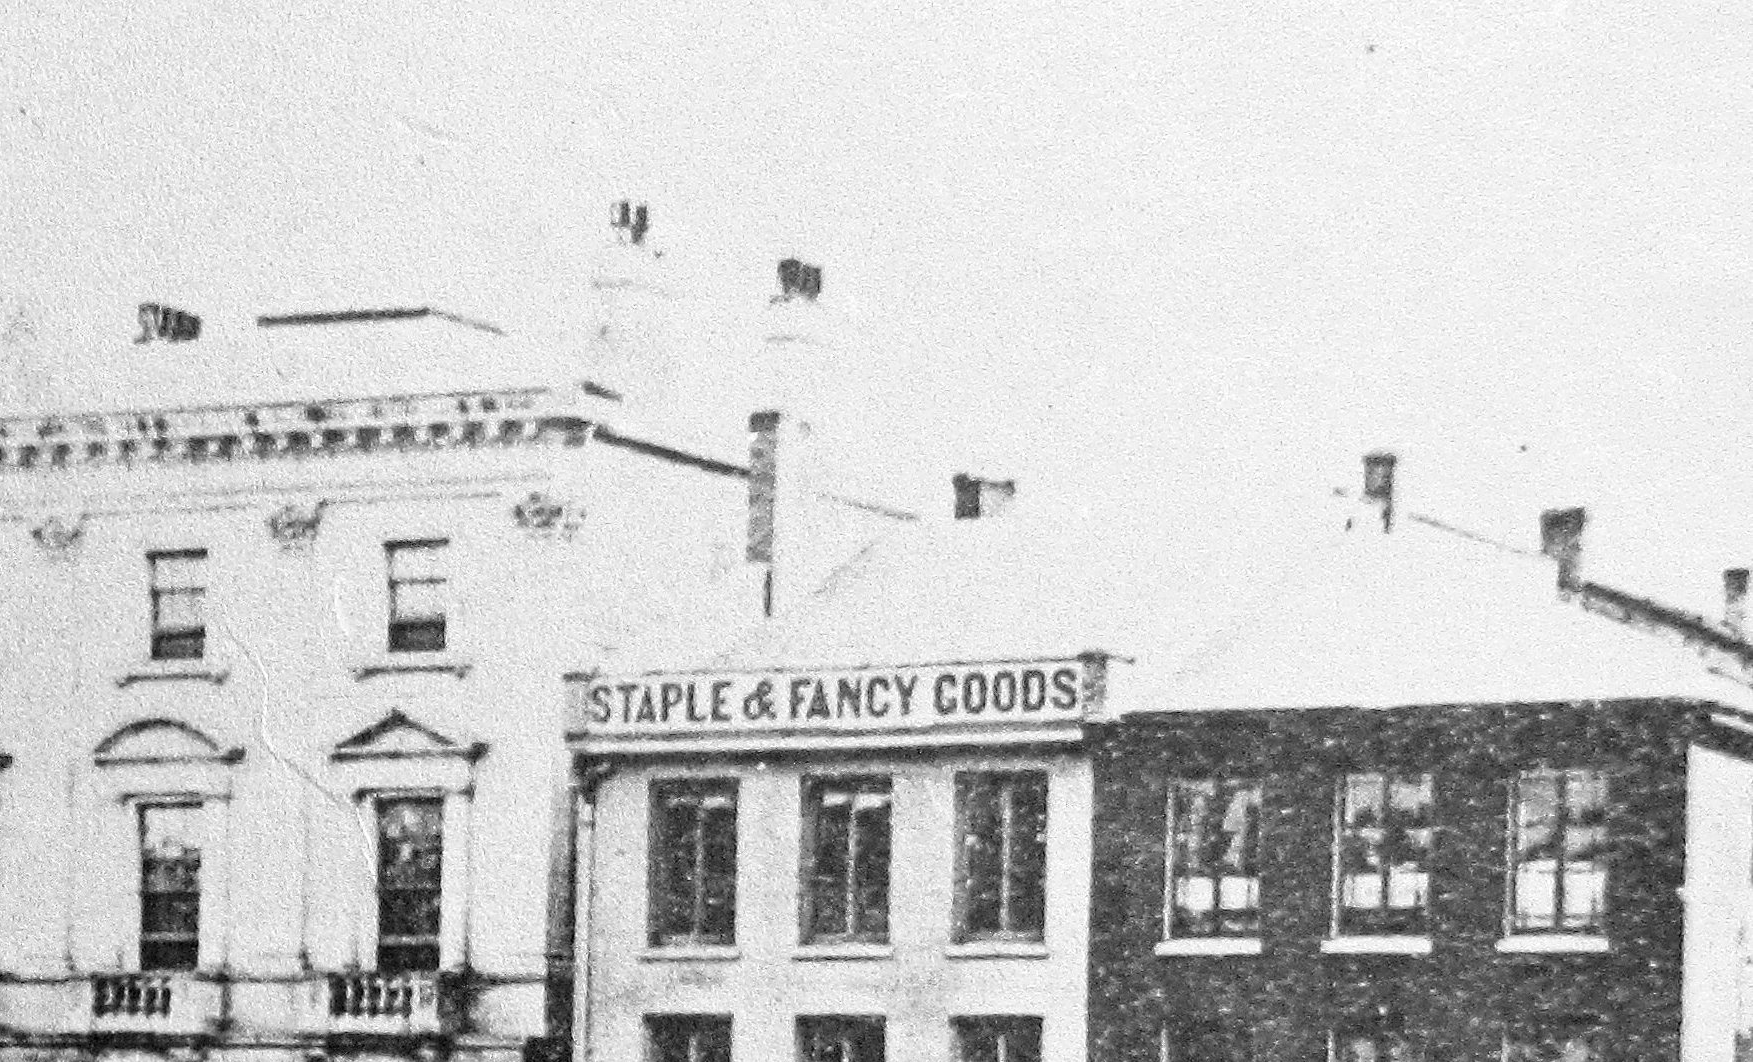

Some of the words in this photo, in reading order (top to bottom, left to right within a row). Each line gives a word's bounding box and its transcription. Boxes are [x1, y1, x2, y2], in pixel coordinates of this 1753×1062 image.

[588, 678, 731, 723] STAPLE
[743, 679, 777, 721] &
[789, 674, 918, 719] FANCY
[933, 668, 1078, 715] GOODS
